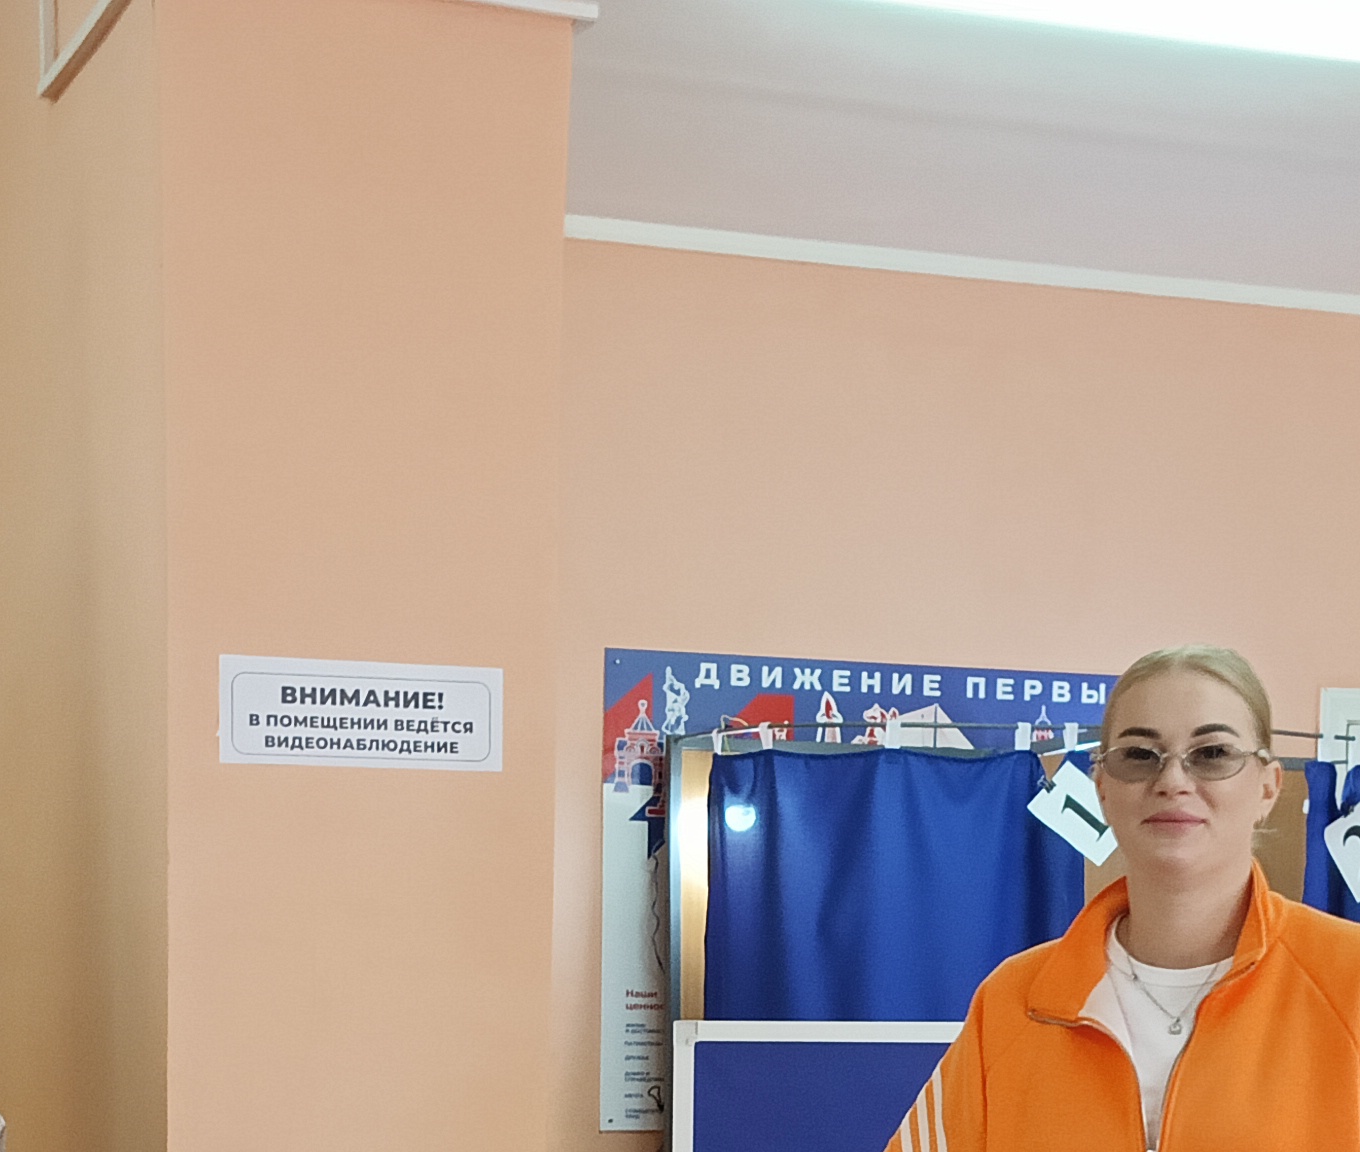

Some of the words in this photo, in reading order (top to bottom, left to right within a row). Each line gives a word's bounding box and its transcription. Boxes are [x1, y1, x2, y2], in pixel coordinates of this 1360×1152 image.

[695, 662, 942, 697] ДВИЖЕНИЕ
[966, 676, 1107, 704] ПЕРВЫ
[280, 685, 445, 711] ВНИМАНИЕ!
[249, 713, 261, 727] В
[266, 714, 389, 731] ПОМЕЩЕНИИ
[394, 716, 474, 735] ВЕДЁТСЯ
[264, 735, 460, 755] ВИДЕОНАБЛЮДЕНИЕ
[1061, 793, 1110, 840] 1
